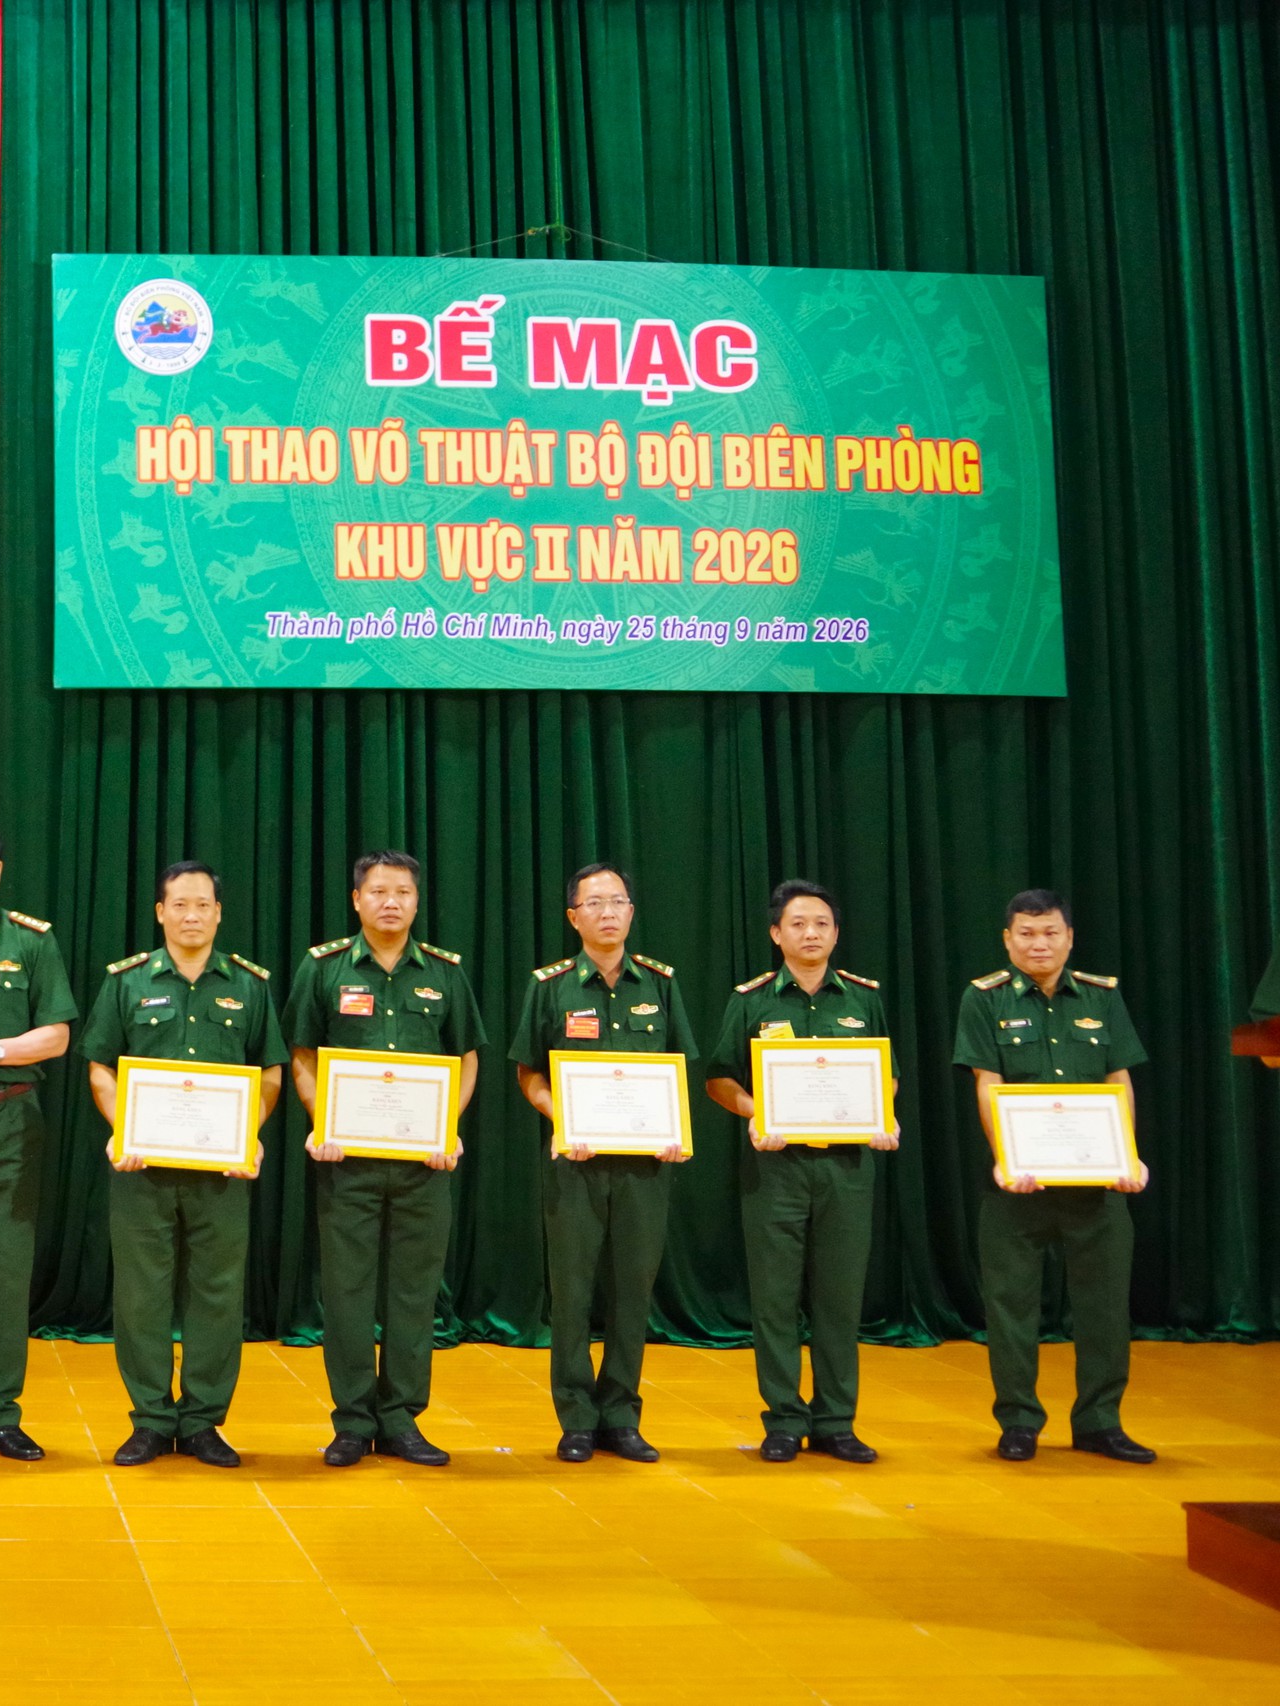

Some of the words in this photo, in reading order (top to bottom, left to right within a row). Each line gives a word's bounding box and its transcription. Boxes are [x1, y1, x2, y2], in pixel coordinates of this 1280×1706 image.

[365, 294, 506, 387] BẾ
[527, 316, 758, 405] MẠC
[137, 415, 214, 495] HỘI
[224, 427, 339, 485] THAO
[350, 418, 410, 485] VÕ
[420, 419, 557, 498] THUẬT
[567, 420, 627, 499] BỘ
[638, 421, 712, 500] ĐỘI
[722, 423, 825, 491] BIÊN
[835, 425, 982, 495] PHÒNG
[335, 523, 425, 581] KHU
[436, 519, 524, 593] VỰC
[532, 524, 571, 583] II
[578, 515, 681, 583] NĂM
[693, 528, 799, 585] 2026
[266, 612, 343, 638] Thành
[346, 608, 396, 644] phố
[402, 608, 437, 638] Hồ
[444, 612, 487, 638] Chí
[490, 614, 556, 643] Minh,
[562, 614, 621, 645] ngày
[628, 615, 655, 639] 25
[661, 615, 729, 645] tháng
[735, 617, 749, 641] 9
[756, 617, 807, 642] năm
[814, 617, 869, 642] 2026
